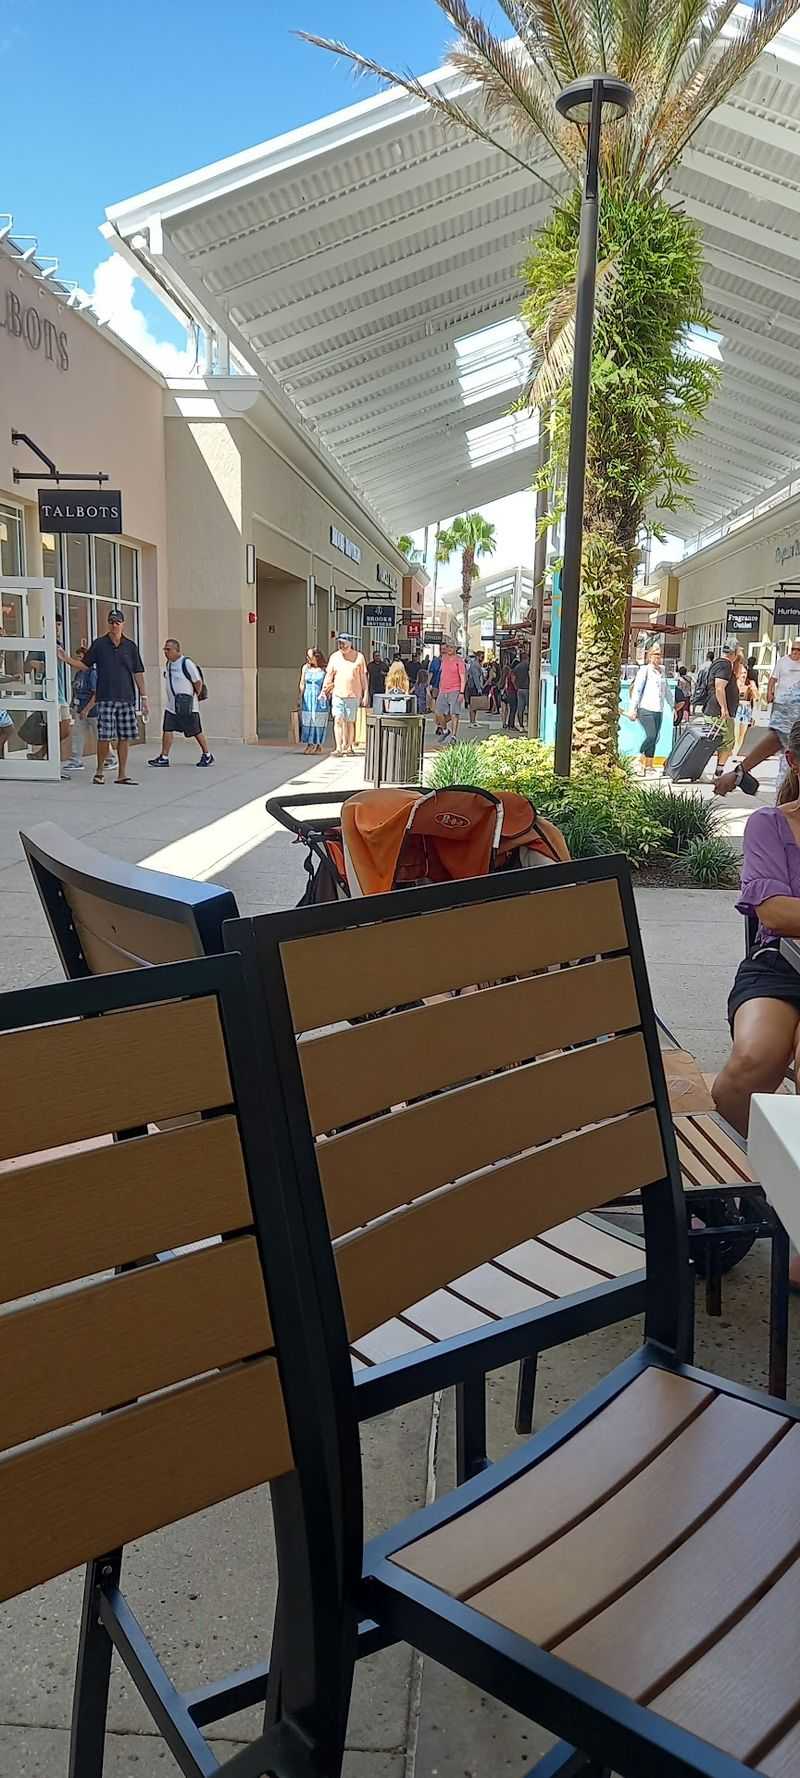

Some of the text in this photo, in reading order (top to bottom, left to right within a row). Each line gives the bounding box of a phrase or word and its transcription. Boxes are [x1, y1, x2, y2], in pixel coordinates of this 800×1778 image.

[0, 290, 69, 371] BOTS
[41, 505, 119, 518] TALBOTS
[728, 614, 758, 622] Fragrance
[734, 621, 752, 629] Outlet
